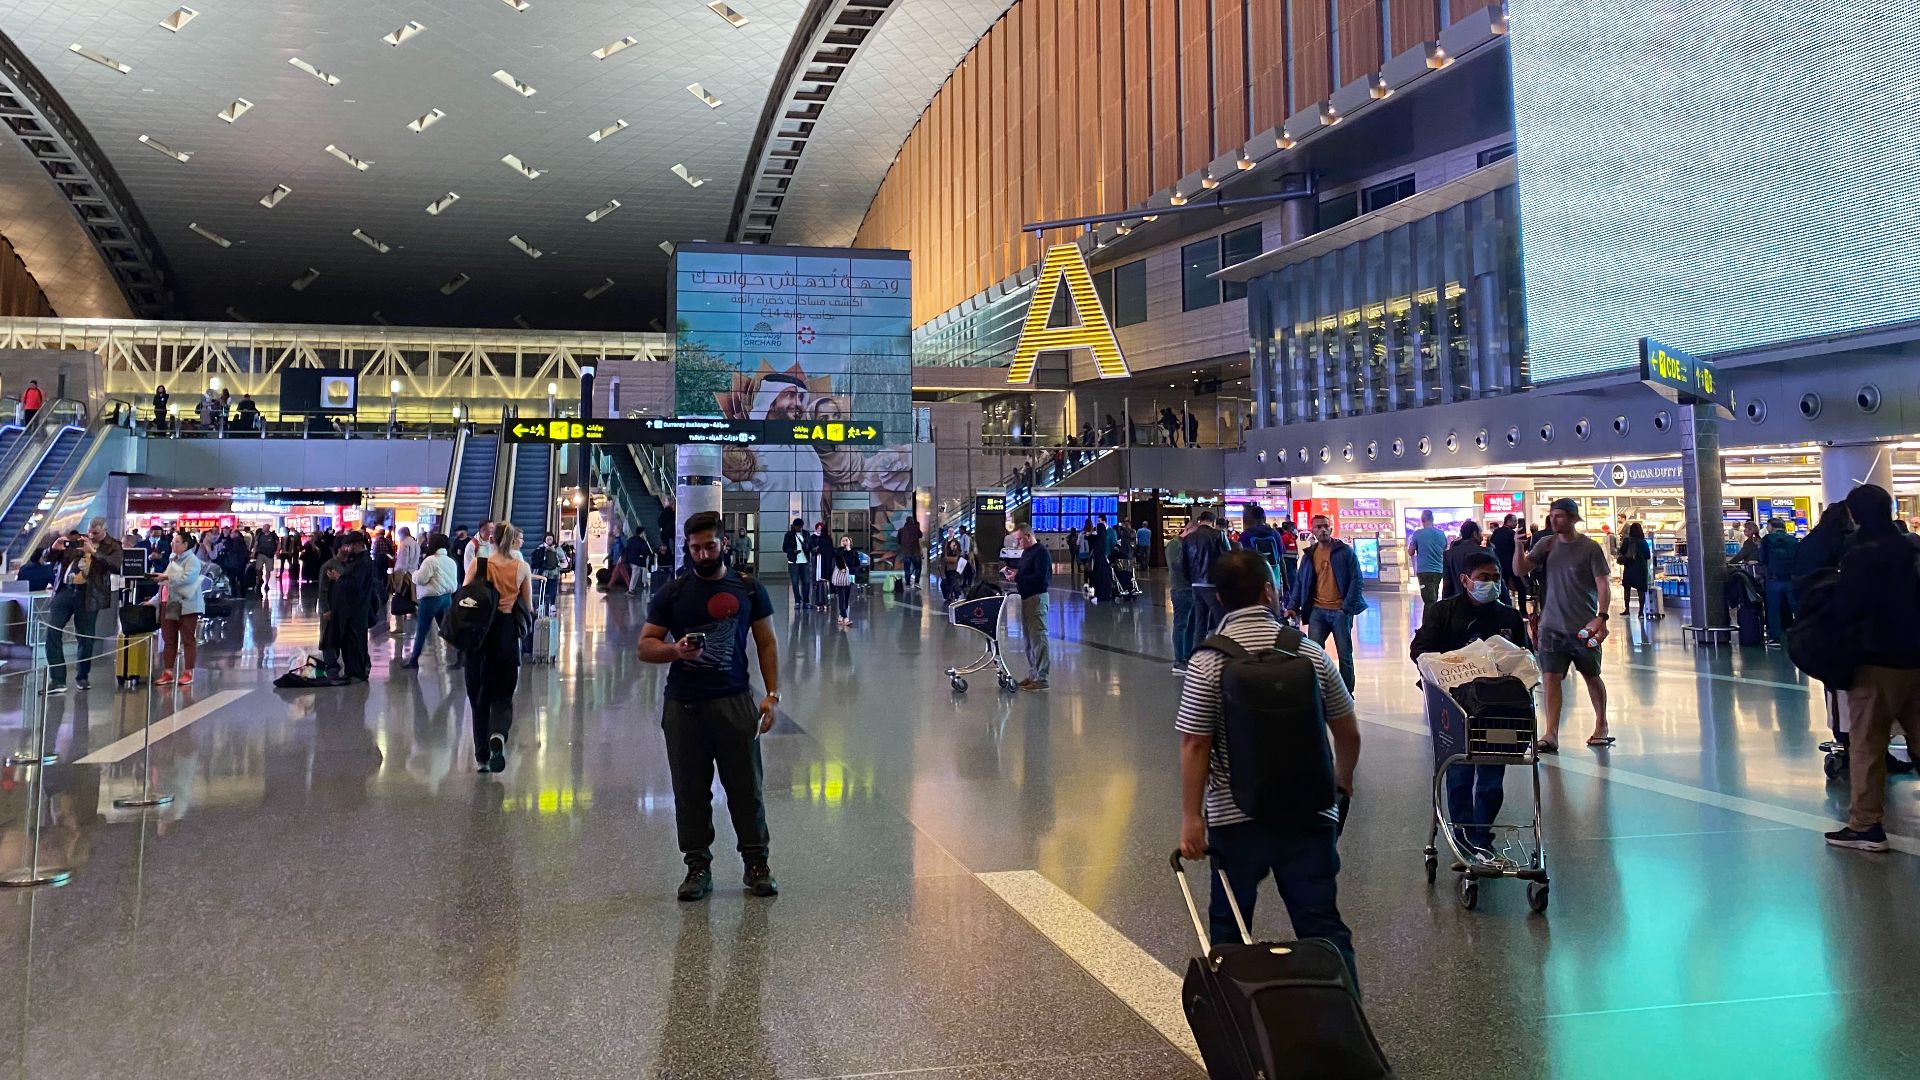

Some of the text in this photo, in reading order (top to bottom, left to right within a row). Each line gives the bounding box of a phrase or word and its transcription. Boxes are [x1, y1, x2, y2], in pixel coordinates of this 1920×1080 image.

[1006, 242, 1131, 384] A
[743, 339, 782, 347] ORCHARD
[570, 423, 584, 438] B
[811, 425, 825, 440] A
[1628, 469, 1654, 480] QATAR
[1654, 467, 1676, 478] DUTY
[1438, 673, 1463, 685] DUTY
[1464, 667, 1488, 678] FREE
[1440, 662, 1478, 676] QATAR
